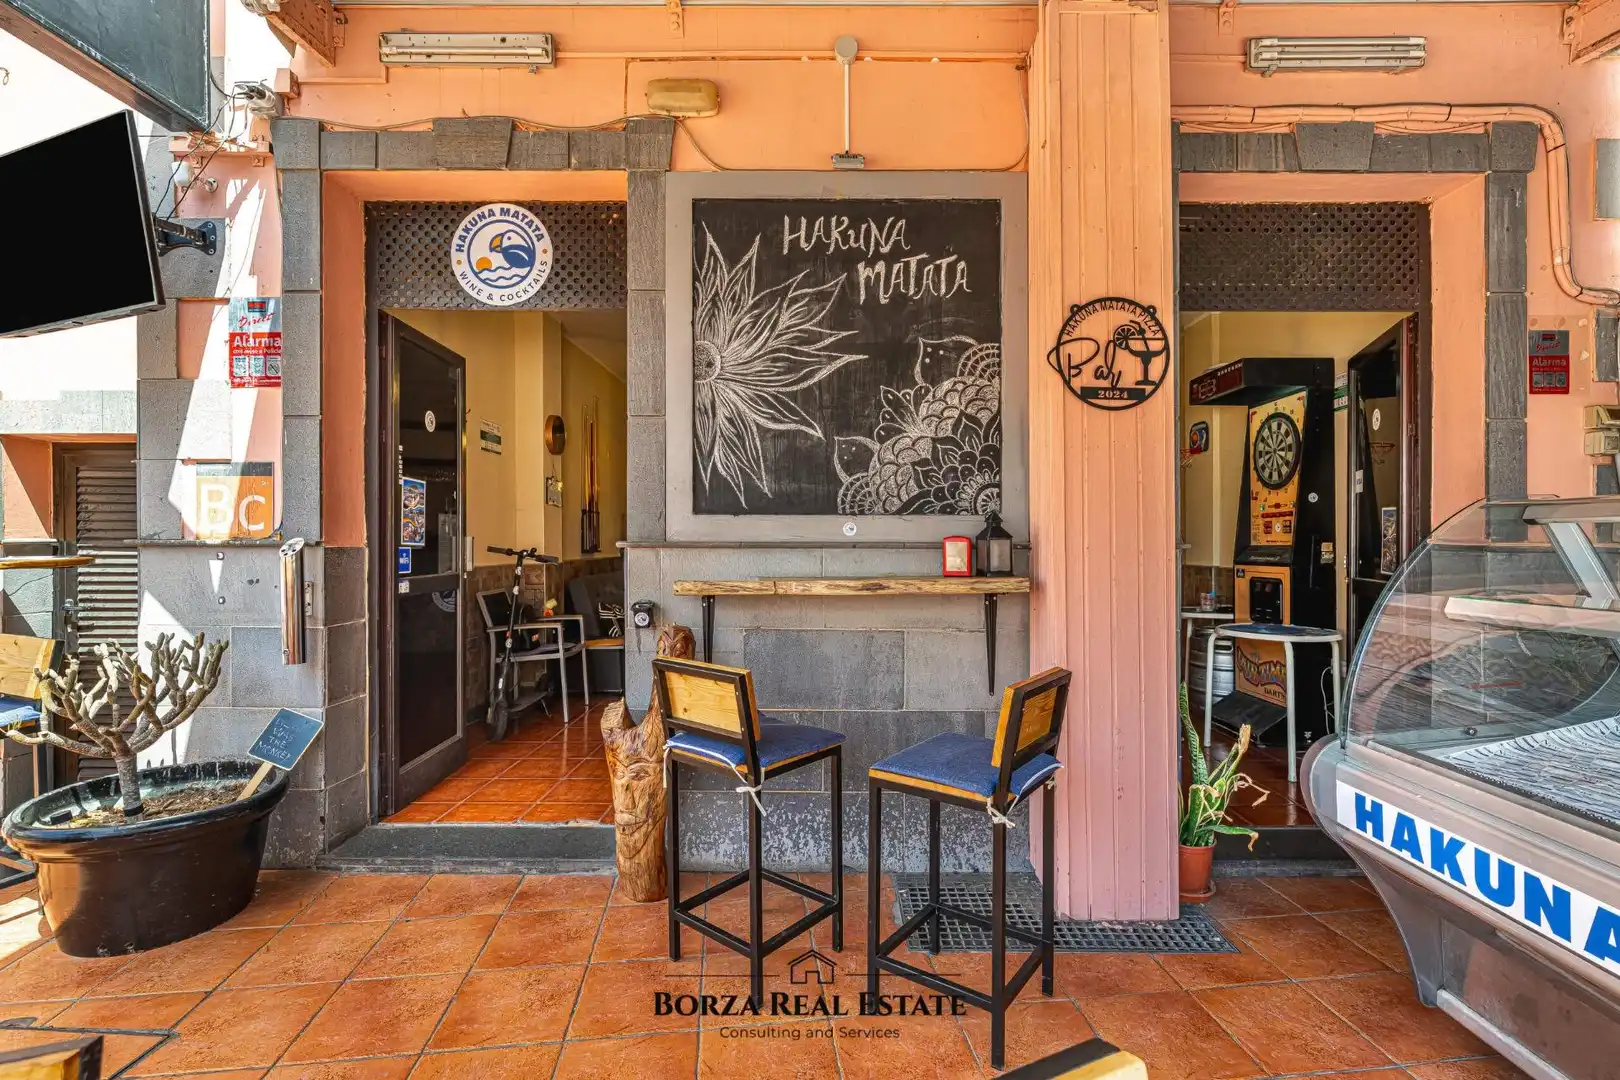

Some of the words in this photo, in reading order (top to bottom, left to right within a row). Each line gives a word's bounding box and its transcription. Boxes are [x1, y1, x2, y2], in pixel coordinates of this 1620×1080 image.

[456, 208, 497, 253] HAKUNA
[499, 207, 545, 243] MATATA
[459, 270, 484, 297] WINE
[486, 292, 494, 301] &
[499, 260, 548, 302] COCKTAILS
[1063, 305, 1099, 338] HAKUNA
[1100, 300, 1138, 315] MATATA
[1137, 311, 1162, 337] PIZZA
[232, 334, 282, 348] Alarma
[1532, 357, 1567, 367] Alarma
[1097, 390, 1129, 399] 2024
[1354, 792, 1620, 965] HAKUNA
